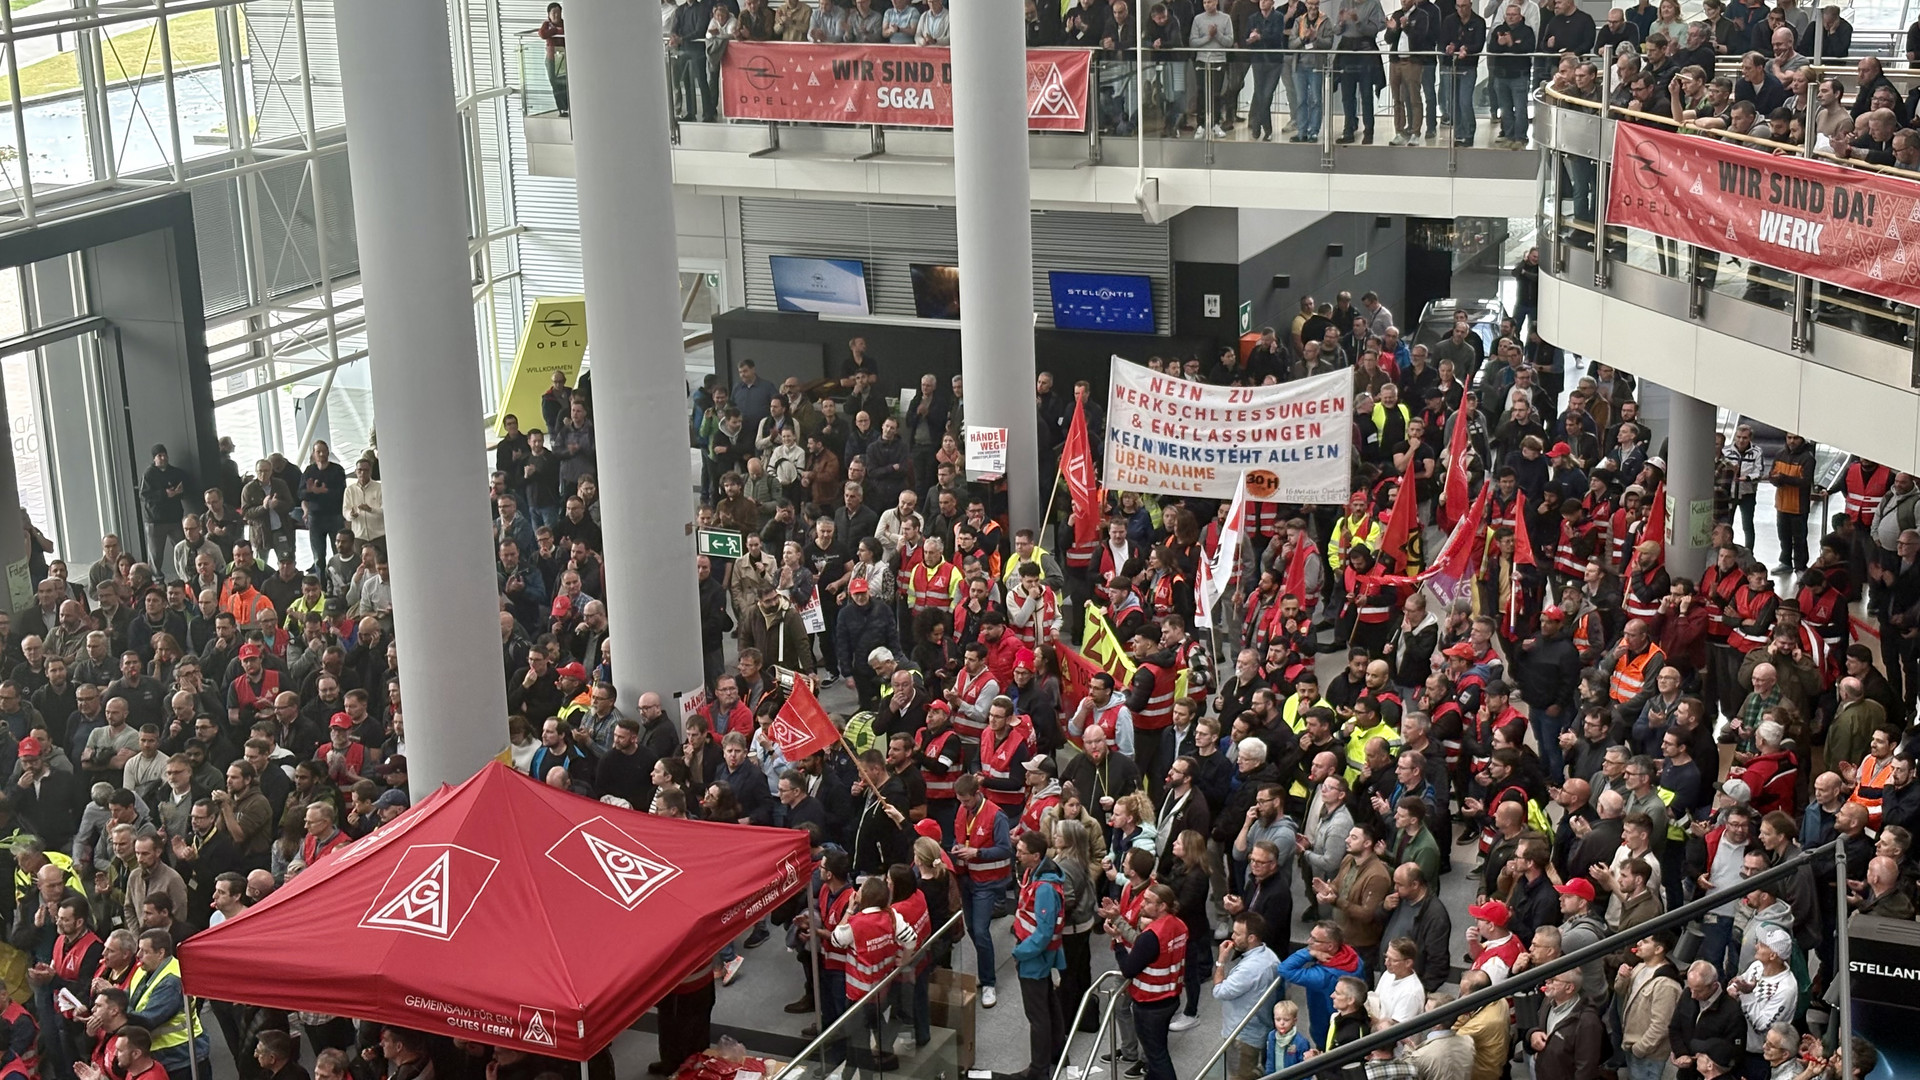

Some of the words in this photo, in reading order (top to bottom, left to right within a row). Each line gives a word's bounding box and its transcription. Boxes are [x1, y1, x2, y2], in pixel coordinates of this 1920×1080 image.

[832, 59, 874, 82] WIR
[882, 61, 934, 83] SIND
[740, 95, 787, 107] OPEL
[877, 86, 935, 110] SG&A
[1623, 194, 1670, 217] OPEL
[1718, 160, 1762, 200] WIR
[1769, 172, 1825, 214] SIND
[1832, 186, 1876, 228] DA!
[1758, 209, 1824, 256] WERK
[1067, 288, 1135, 299] STELLANTIS
[536, 340, 581, 349] OPEL
[526, 364, 573, 374] WILLKOMMEN
[1150, 377, 1203, 401] NEIN
[1228, 389, 1254, 403] ZU
[1116, 384, 1345, 422] WERKSCHLIESSUNGEN
[970, 431, 999, 442] HÄNDE
[1131, 413, 1142, 429] &
[1151, 419, 1321, 442] ENTLASSUNGEN
[1111, 427, 1152, 454] KEIN
[1268, 444, 1338, 463] ALLEIN
[1115, 444, 1215, 480] ÜBERNAHME
[1117, 466, 1149, 486] FÜR
[1160, 479, 1203, 492] ALLE
[1849, 960, 1920, 981] STELLANT
[405, 994, 471, 1017] GEMEINSAM
[473, 1008, 493, 1022] FÜR
[495, 1014, 513, 1025] EIN
[447, 1016, 480, 1032] GUTES
[482, 1022, 515, 1038] LEBEN
